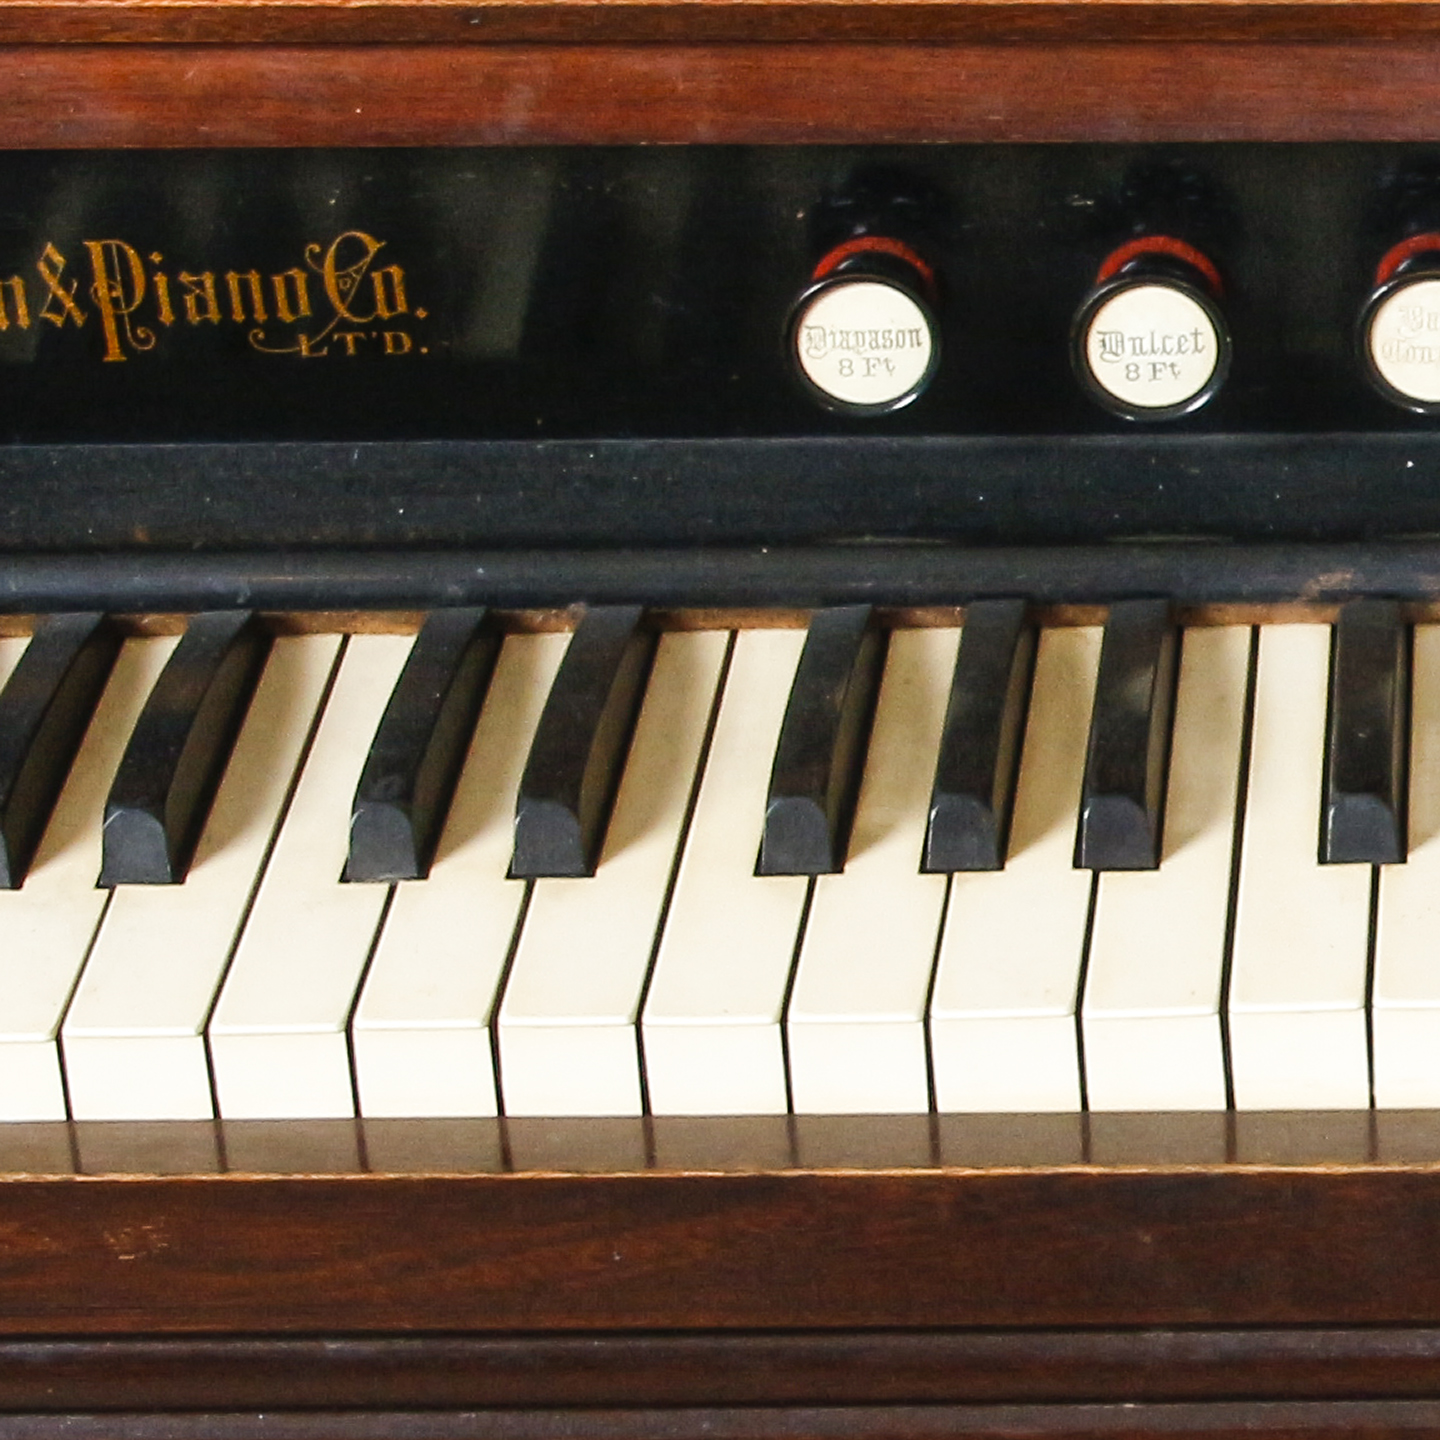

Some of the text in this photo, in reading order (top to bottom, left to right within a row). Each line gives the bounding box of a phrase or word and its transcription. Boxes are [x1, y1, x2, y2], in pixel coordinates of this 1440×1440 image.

[83, 239, 312, 361] Piano
[805, 325, 923, 359] Diapason
[1096, 327, 1207, 363] Dulcet
[838, 357, 897, 378] 8 Ft
[1125, 362, 1182, 382] 8 Ft
